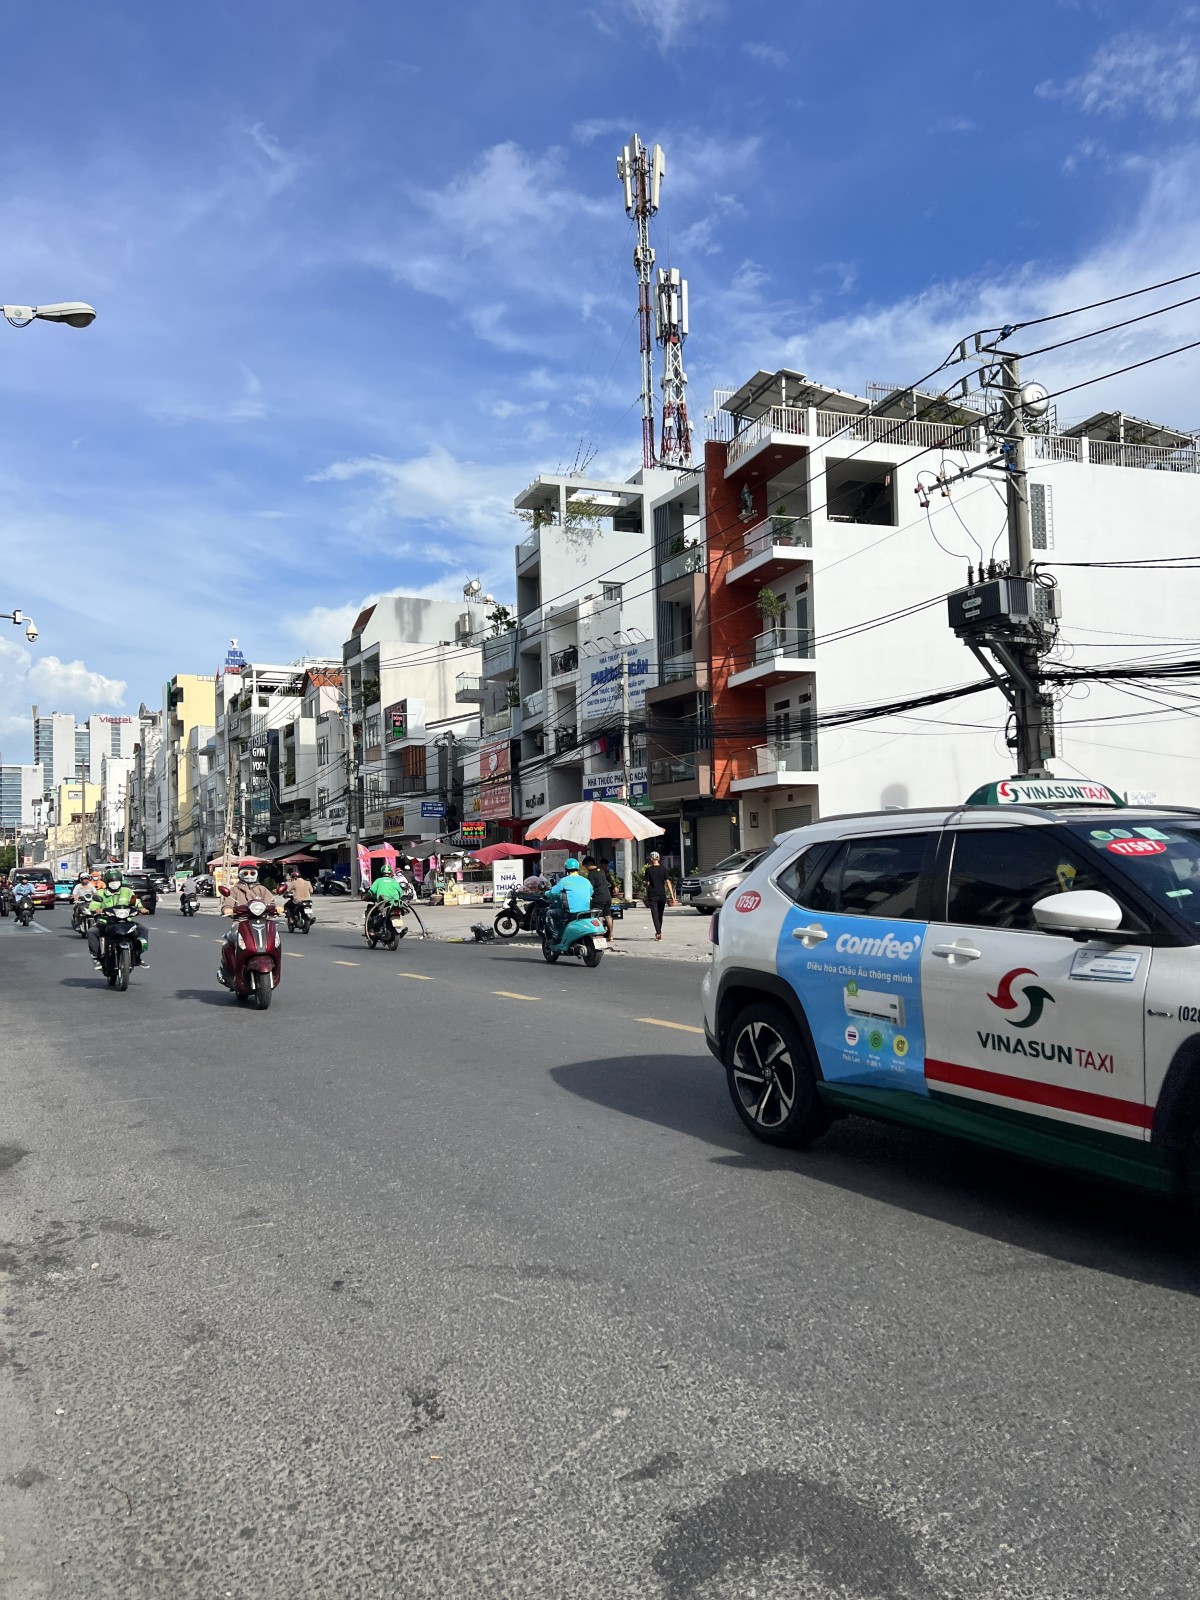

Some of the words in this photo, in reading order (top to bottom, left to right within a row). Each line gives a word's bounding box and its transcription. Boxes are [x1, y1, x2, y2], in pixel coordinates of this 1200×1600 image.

[252, 748, 266, 757] GYM
[252, 762, 266, 771] YOGA
[588, 778, 596, 786] NHÀ
[598, 773, 614, 786] THUỐC
[1111, 841, 1161, 853] 17597
[496, 882, 522, 891] THUỐC
[736, 893, 760, 909] 17597
[807, 962, 822, 971] Điều
[824, 964, 836, 973] hòa
[838, 965, 856, 976] Châu
[858, 966, 868, 977] Âu
[869, 969, 891, 983] thông
[892, 973, 913, 983] minh
